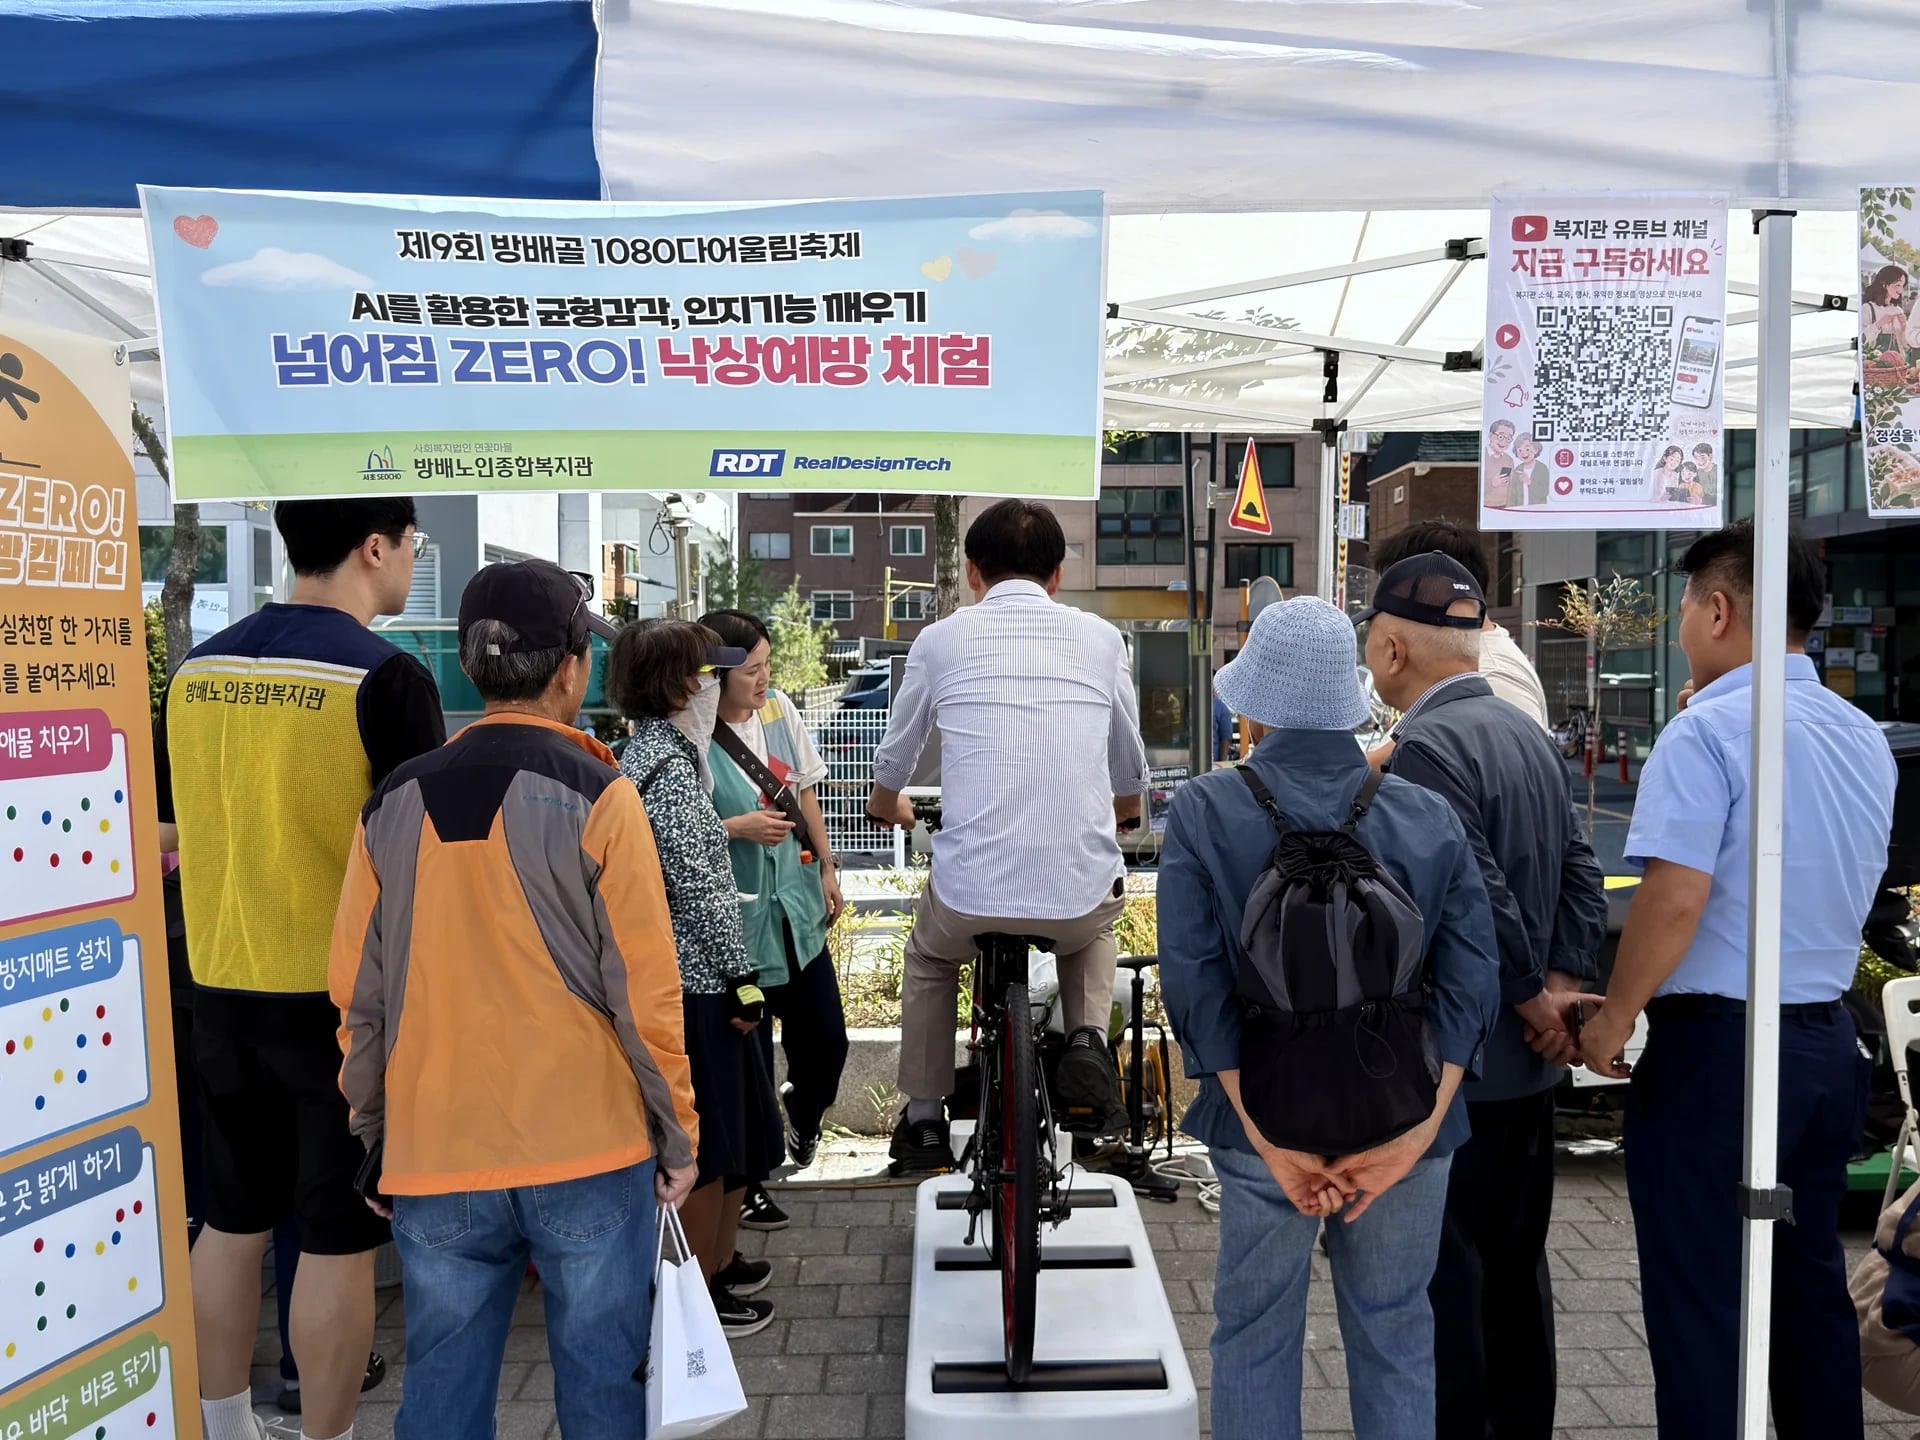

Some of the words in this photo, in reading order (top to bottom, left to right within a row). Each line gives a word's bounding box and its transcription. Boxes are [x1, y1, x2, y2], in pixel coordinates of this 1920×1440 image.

[1553, 219, 1608, 240] 복지관
[1613, 219, 1667, 239] 유튜브
[1672, 219, 1709, 239] 채널
[397, 231, 484, 261] 제9회
[491, 234, 585, 265] 방배골
[592, 232, 860, 265] 1080다어울림축제
[1511, 248, 1565, 278] 지금
[1573, 247, 1710, 278] 구독하세요
[352, 293, 420, 325] AI를
[427, 294, 529, 327] 활용한
[536, 297, 680, 330] 균형감각,
[686, 294, 816, 325] 인지기능
[824, 291, 925, 324] 깨우기
[1515, 290, 1536, 300] 복지관
[272, 334, 439, 386] 넘어짐
[449, 337, 646, 385] ZERO!
[659, 335, 871, 386] 낙상예방
[883, 334, 991, 387] 체험
[413, 443, 472, 454] 사회복지법인
[1876, 429, 1914, 443] 정성을
[376, 472, 402, 481] SEOCHO
[413, 456, 594, 479] 방배노인종합복지관
[716, 453, 779, 473] RDT
[793, 456, 951, 472] RealDesignTech
[0, 472, 125, 538] ZERO!
[0, 614, 54, 646] 실천할
[60, 616, 78, 645] 한
[84, 617, 132, 646] 가지를
[0, 663, 19, 694] 를
[26, 662, 116, 694] 붙여주세요!
[186, 680, 326, 711] 방배노인종합복지관
[39, 724, 90, 755] 치우기
[0, 946, 72, 991] 방지매트
[76, 935, 111, 972] 설치
[13, 1179, 33, 1216] 곳
[38, 1159, 78, 1205] 밝게
[83, 1143, 121, 1181] 하기
[29, 1394, 69, 1436] 바닥
[80, 1370, 118, 1407] 바로
[121, 1345, 157, 1388] 닦기
